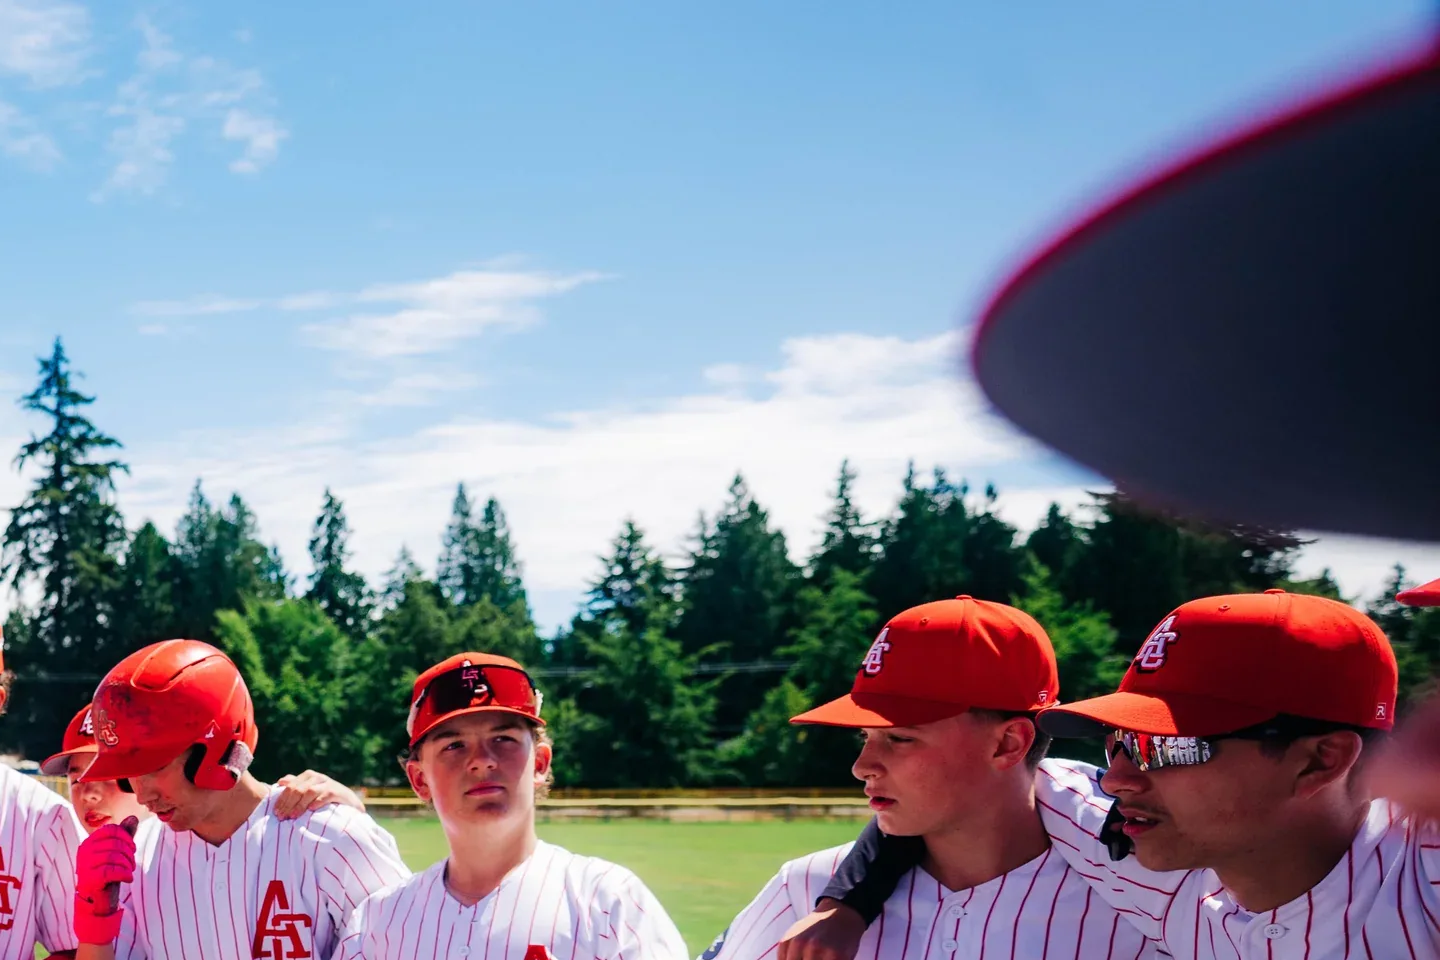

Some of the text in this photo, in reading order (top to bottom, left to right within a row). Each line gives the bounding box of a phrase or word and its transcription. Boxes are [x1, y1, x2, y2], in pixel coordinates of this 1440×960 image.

[862, 627, 890, 673] AC
[1136, 615, 1177, 669] AC
[98, 709, 119, 746] AC
